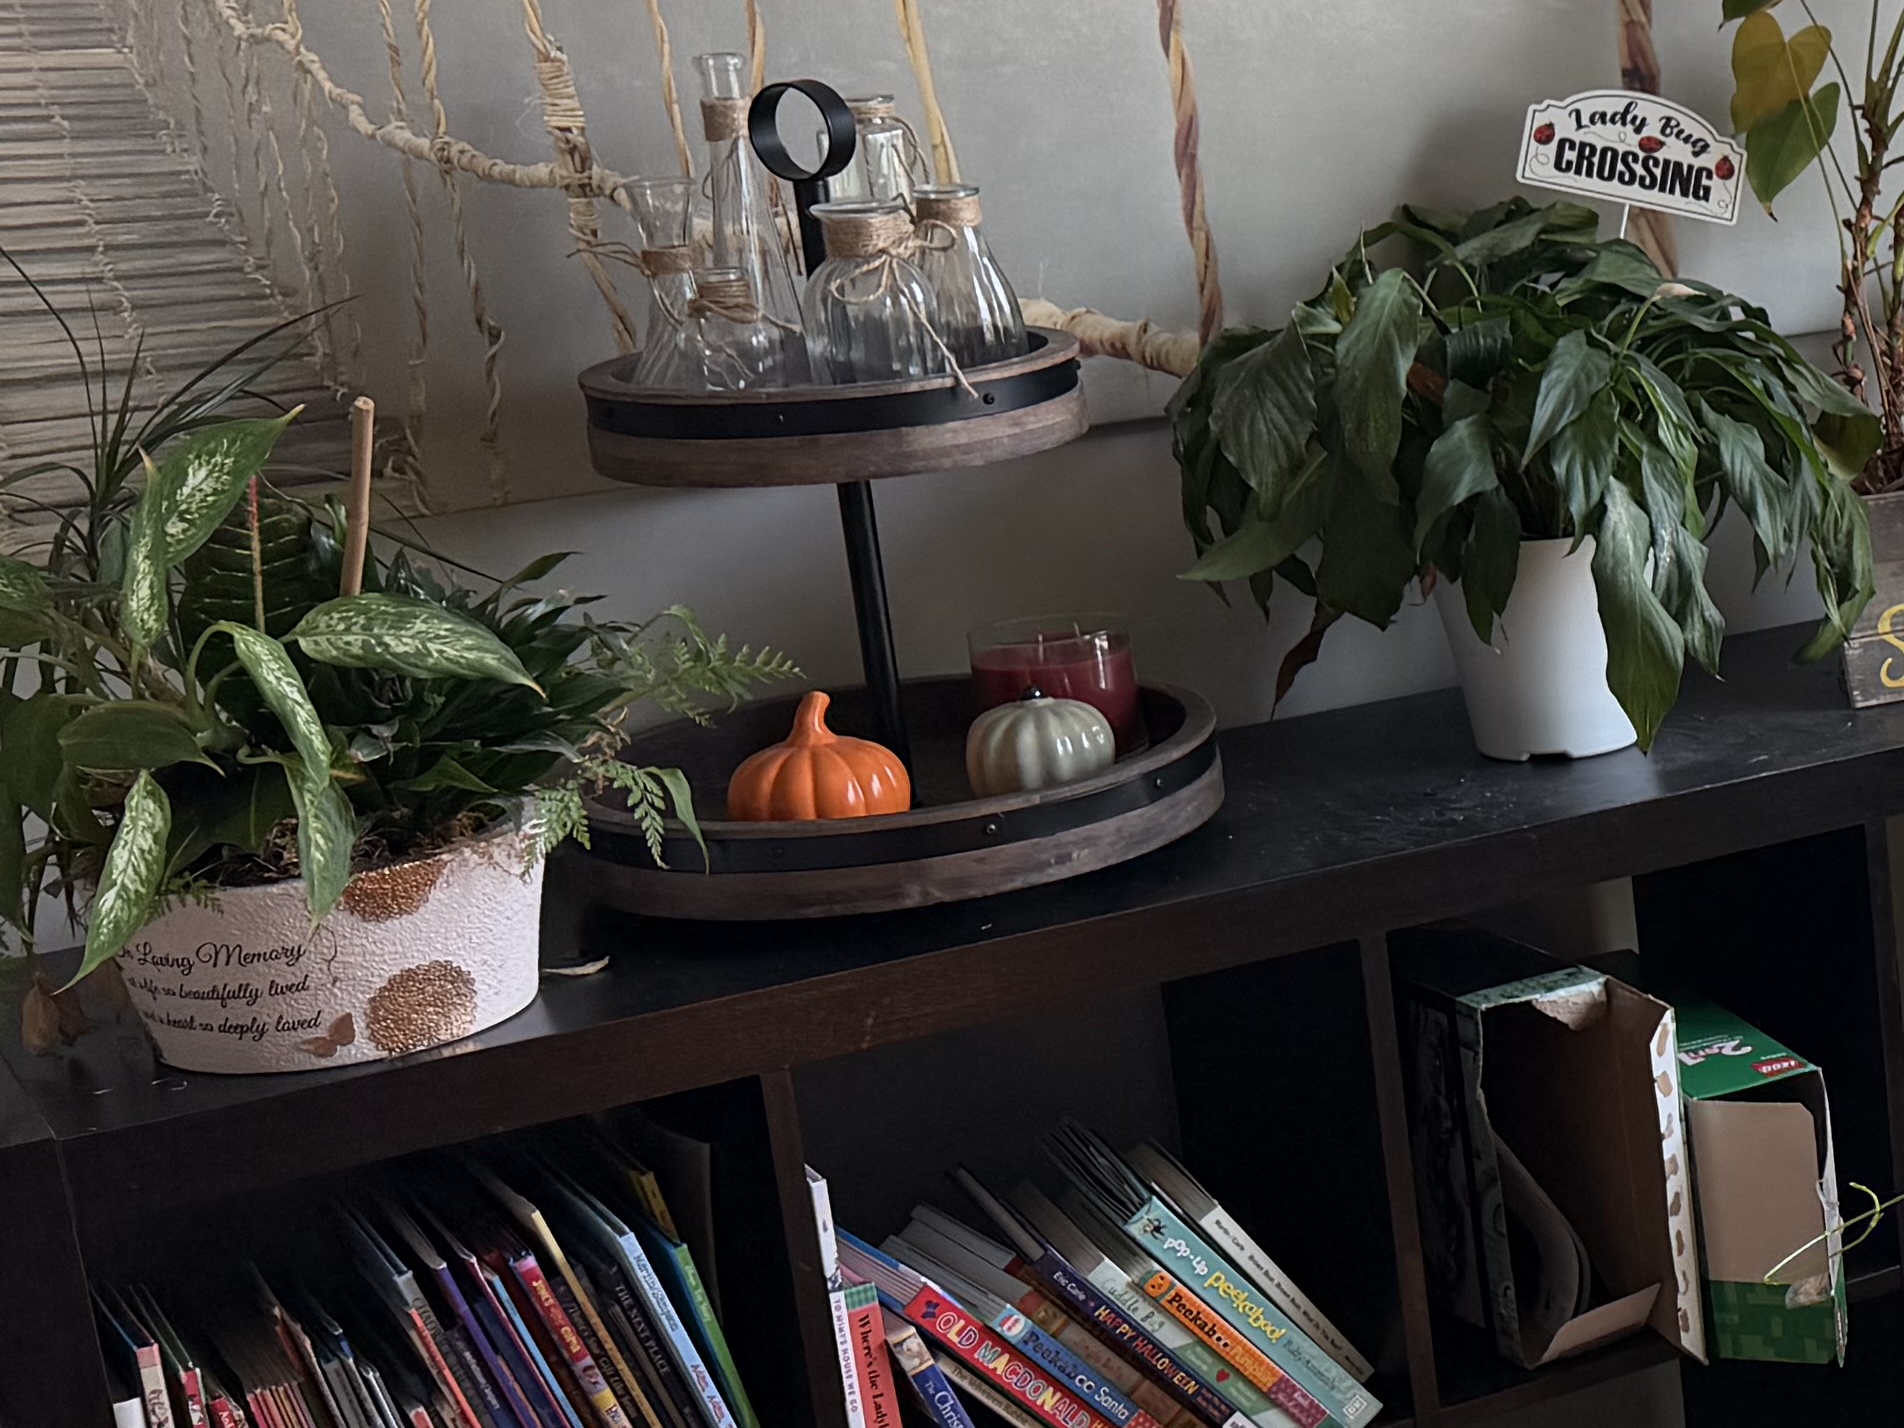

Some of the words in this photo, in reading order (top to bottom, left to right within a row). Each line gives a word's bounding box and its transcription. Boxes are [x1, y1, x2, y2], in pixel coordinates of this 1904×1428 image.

[1568, 100, 1649, 135] Lady
[1658, 115, 1712, 157] Bug
[1553, 137, 1713, 204] CROSSING
[136, 941, 195, 976] Loving
[196, 942, 306, 967] Memory
[179, 985, 263, 1008] beautifully
[269, 974, 309, 997] lived
[218, 1016, 269, 1042] deeply
[275, 1010, 322, 1033] loved
[832, 1298, 842, 1312] TO
[1051, 1269, 1070, 1288] Eric
[1064, 1281, 1088, 1303] Carle
[1099, 1273, 1144, 1316] Cuddle
[1160, 1231, 1212, 1281] pop-up
[1202, 1266, 1289, 1349] peekaboo!
[612, 1282, 634, 1310] THE
[626, 1307, 651, 1340] NEXT
[644, 1338, 671, 1376] PLACE
[855, 1313, 879, 1370] Where's
[931, 1306, 983, 1354] OLD
[1092, 1302, 1137, 1344] HAPPY
[1130, 1333, 1201, 1398] HALLOWEEN
[866, 1369, 882, 1390] the
[923, 1379, 938, 1395] The
[950, 1365, 969, 1382] The
[1001, 1402, 1030, 1427] Rabbit
[1019, 1329, 1097, 1397] Peekaboo
[1092, 1384, 1133, 1422] Santa
